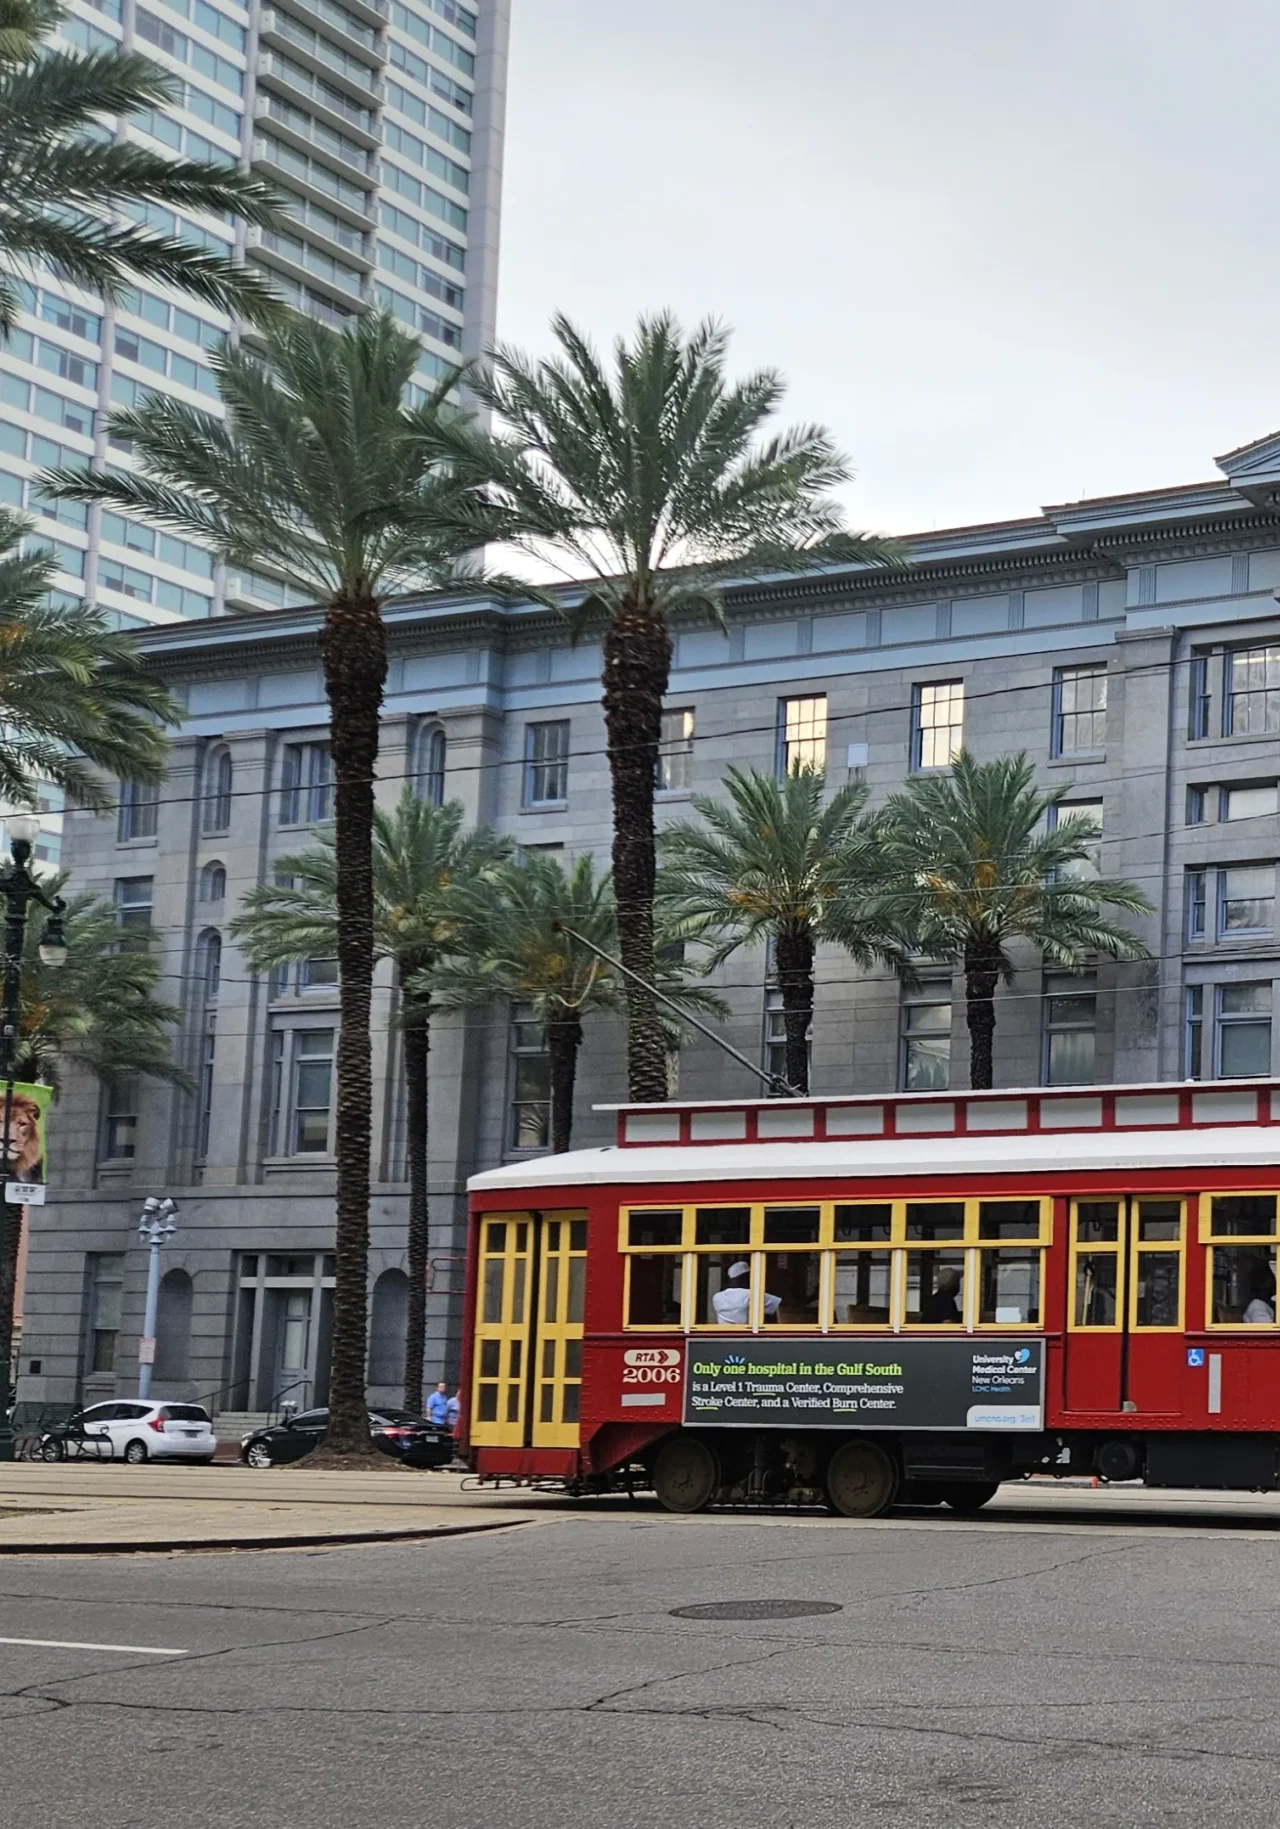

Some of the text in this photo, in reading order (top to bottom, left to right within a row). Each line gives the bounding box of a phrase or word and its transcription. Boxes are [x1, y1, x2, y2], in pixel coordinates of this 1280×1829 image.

[635, 1352, 655, 1362] RTA
[972, 1355, 1014, 1365] University
[692, 1362, 902, 1377] Only one hospital in the Gulf South
[972, 1365, 1037, 1374] Medical Center
[622, 1367, 681, 1384] 2006
[972, 1375, 1025, 1384] New Orleans
[692, 1381, 904, 1395] is a Level 1 Trauma Center, Comprehensive
[691, 1396, 723, 1406] Stroke
[724, 1396, 760, 1408] Center,
[761, 1397, 781, 1407] and
[791, 1397, 831, 1408] Verified
[832, 1397, 858, 1408] Burn
[859, 1397, 897, 1409] Center.
